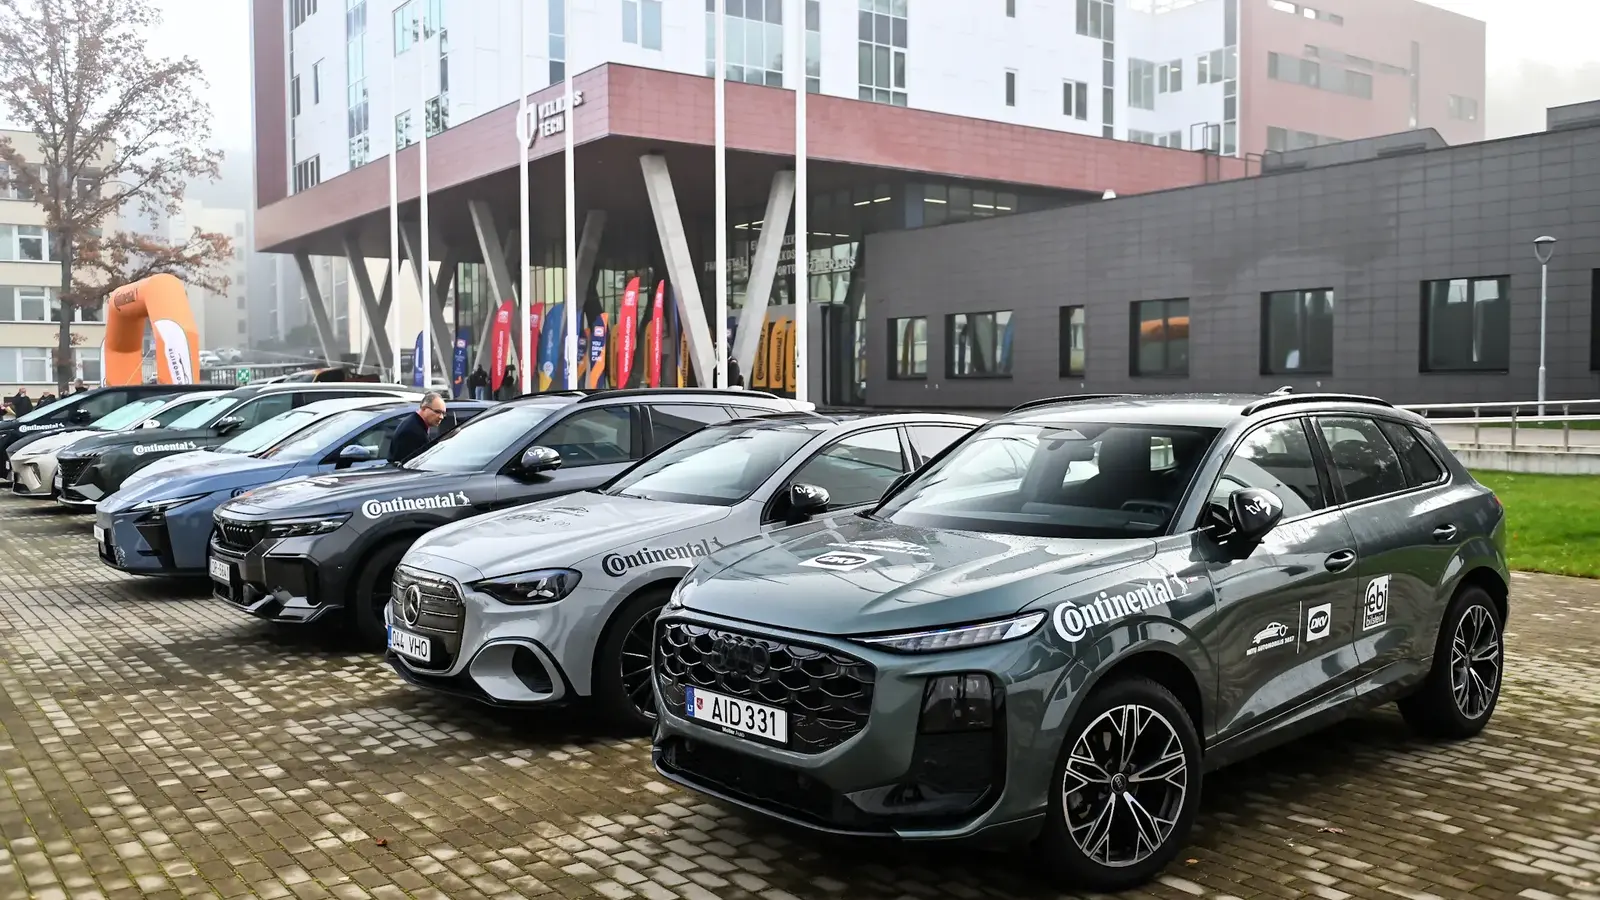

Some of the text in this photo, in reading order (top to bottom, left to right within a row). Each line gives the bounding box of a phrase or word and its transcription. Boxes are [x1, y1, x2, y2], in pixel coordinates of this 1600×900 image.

[538, 91, 582, 119] VILNS
[132, 441, 189, 456] Continental
[361, 492, 457, 519] Continental
[1244, 496, 1271, 516] tv3
[601, 539, 711, 577] Continental
[1053, 573, 1176, 643] Continental
[1365, 581, 1387, 613] febi
[1310, 615, 1328, 630] DKV
[409, 635, 428, 658] VHO
[712, 697, 741, 726] AID
[745, 705, 776, 736] 331
